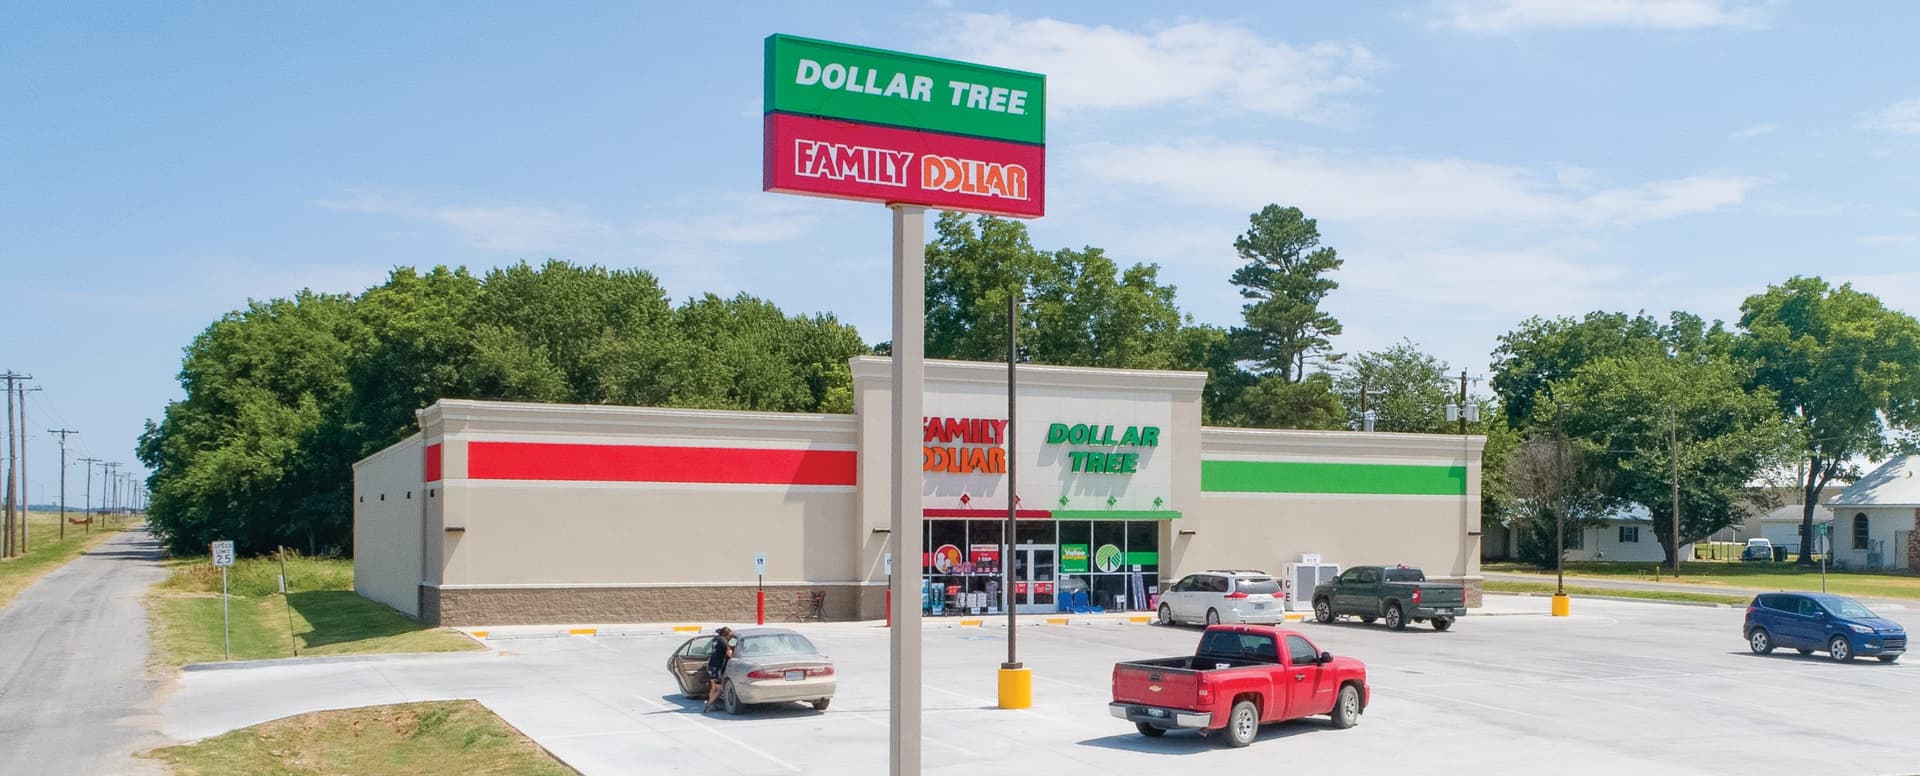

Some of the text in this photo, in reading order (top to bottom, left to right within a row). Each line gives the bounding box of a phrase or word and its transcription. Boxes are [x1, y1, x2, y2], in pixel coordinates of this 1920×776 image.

[796, 59, 1028, 115] DOLLAR TREE
[795, 138, 1028, 200] FAMILY DOLLAR
[923, 416, 1008, 444] AMILY
[1047, 423, 1160, 447] DOLLAR
[1068, 451, 1139, 474] TREE
[216, 554, 231, 564] 25
